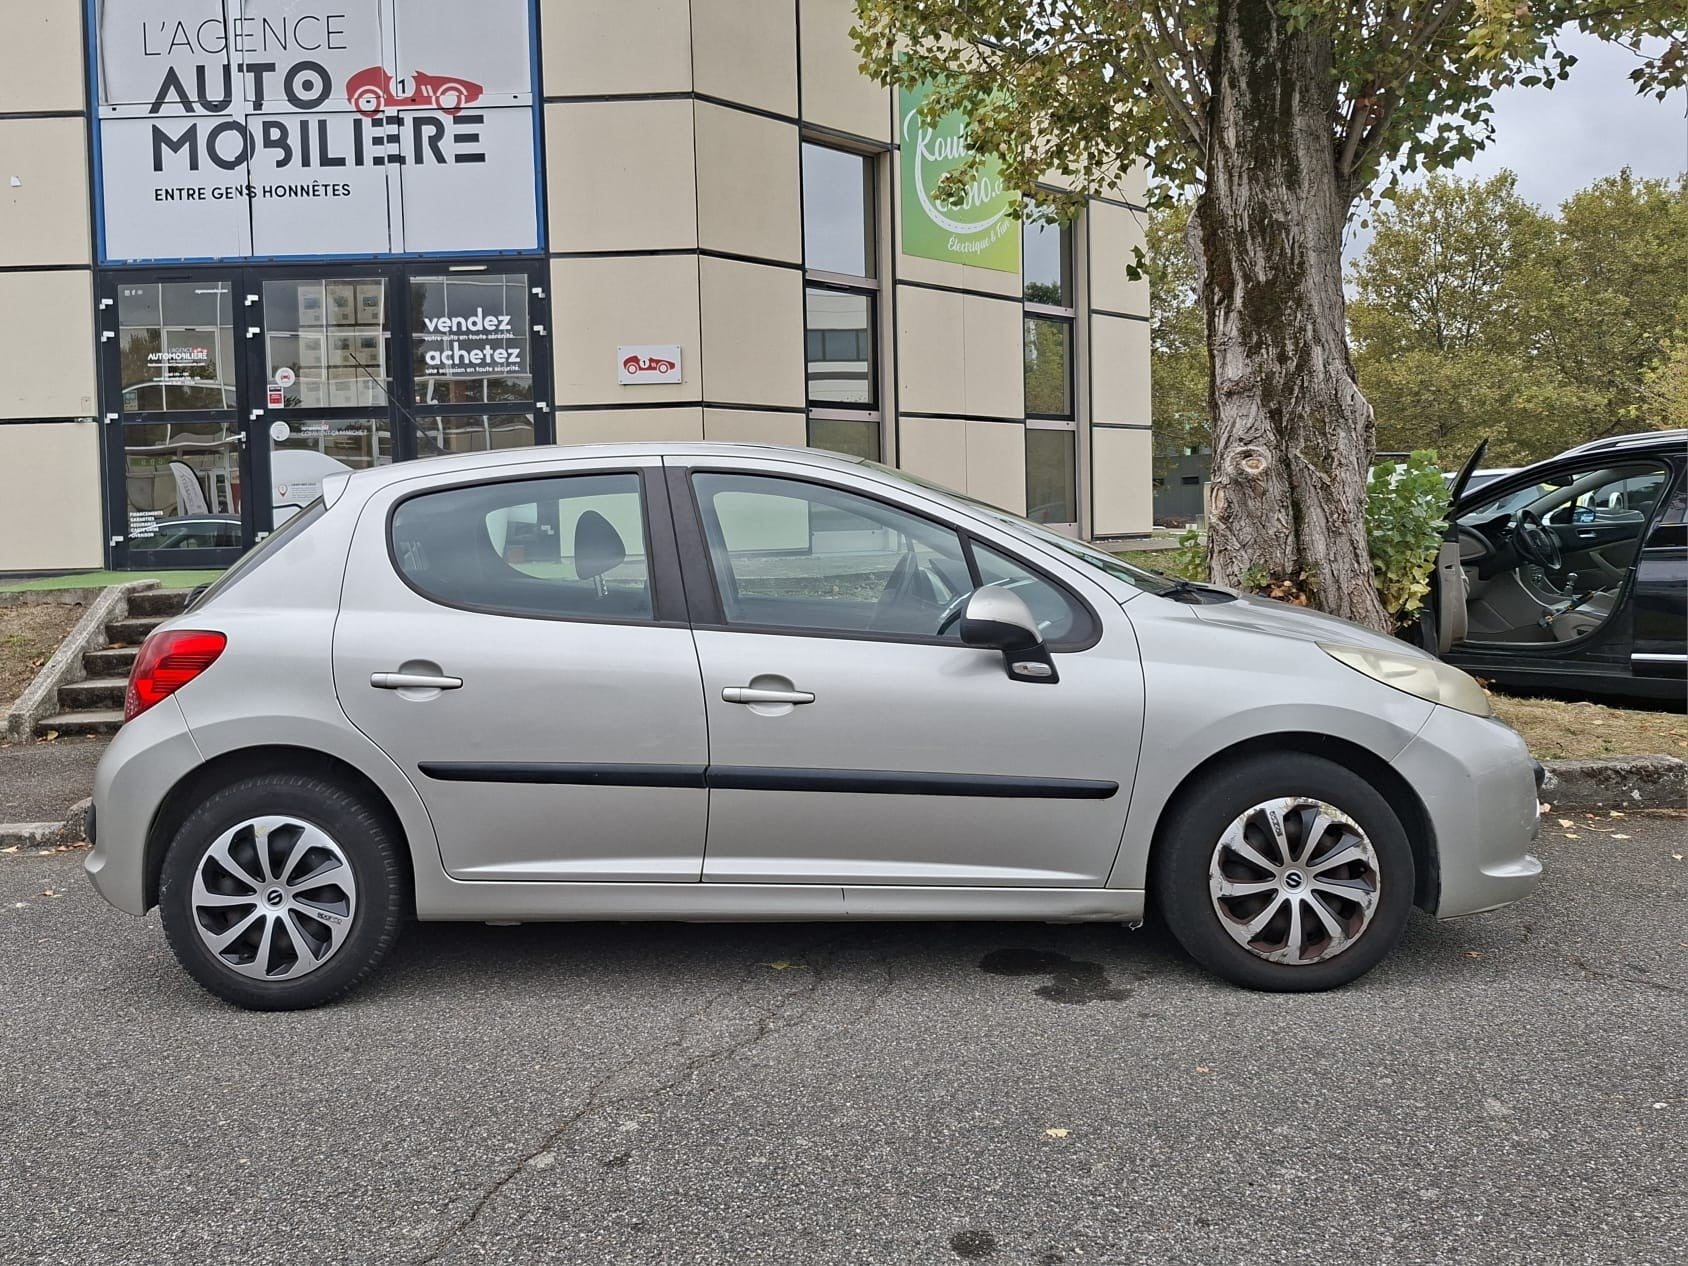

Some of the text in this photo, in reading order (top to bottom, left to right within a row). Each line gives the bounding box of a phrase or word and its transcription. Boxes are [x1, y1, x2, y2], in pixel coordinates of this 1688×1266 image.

[142, 15, 347, 56] L'AGENCE
[148, 60, 333, 114] AUTO
[154, 180, 351, 201] ENTRE GENS HONNÊTES
[424, 307, 512, 332] vendez
[425, 341, 520, 365] achetez
[476, 364, 493, 372] toute
